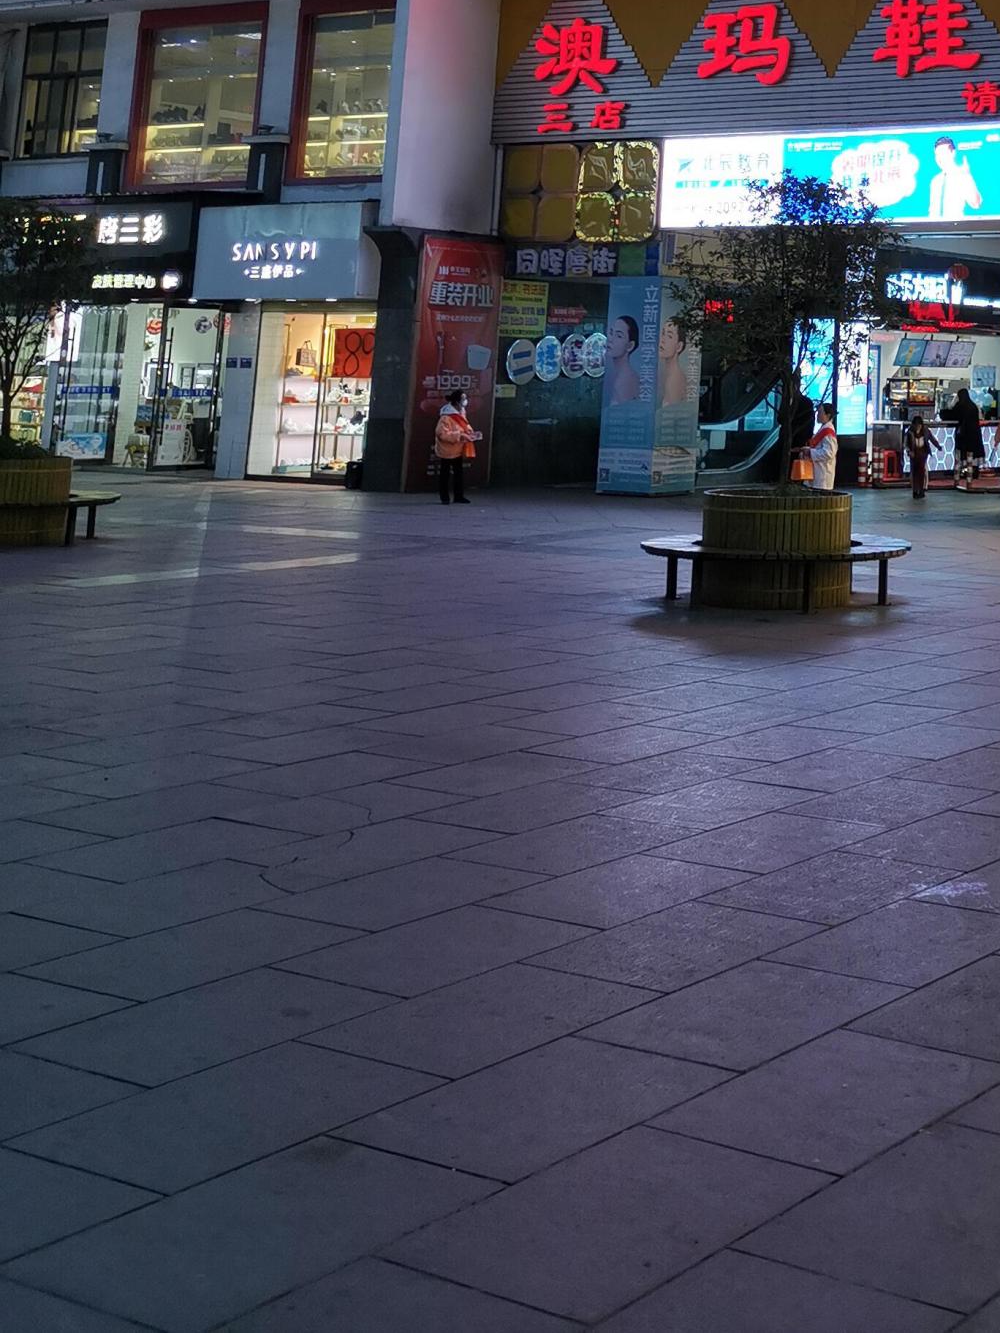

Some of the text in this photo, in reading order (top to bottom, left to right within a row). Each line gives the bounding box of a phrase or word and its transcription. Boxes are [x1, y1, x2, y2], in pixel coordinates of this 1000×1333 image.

[536, 100, 627, 134] 三店
[428, 280, 494, 308] 重装开业
[639, 284, 660, 403] 立新医学美容
